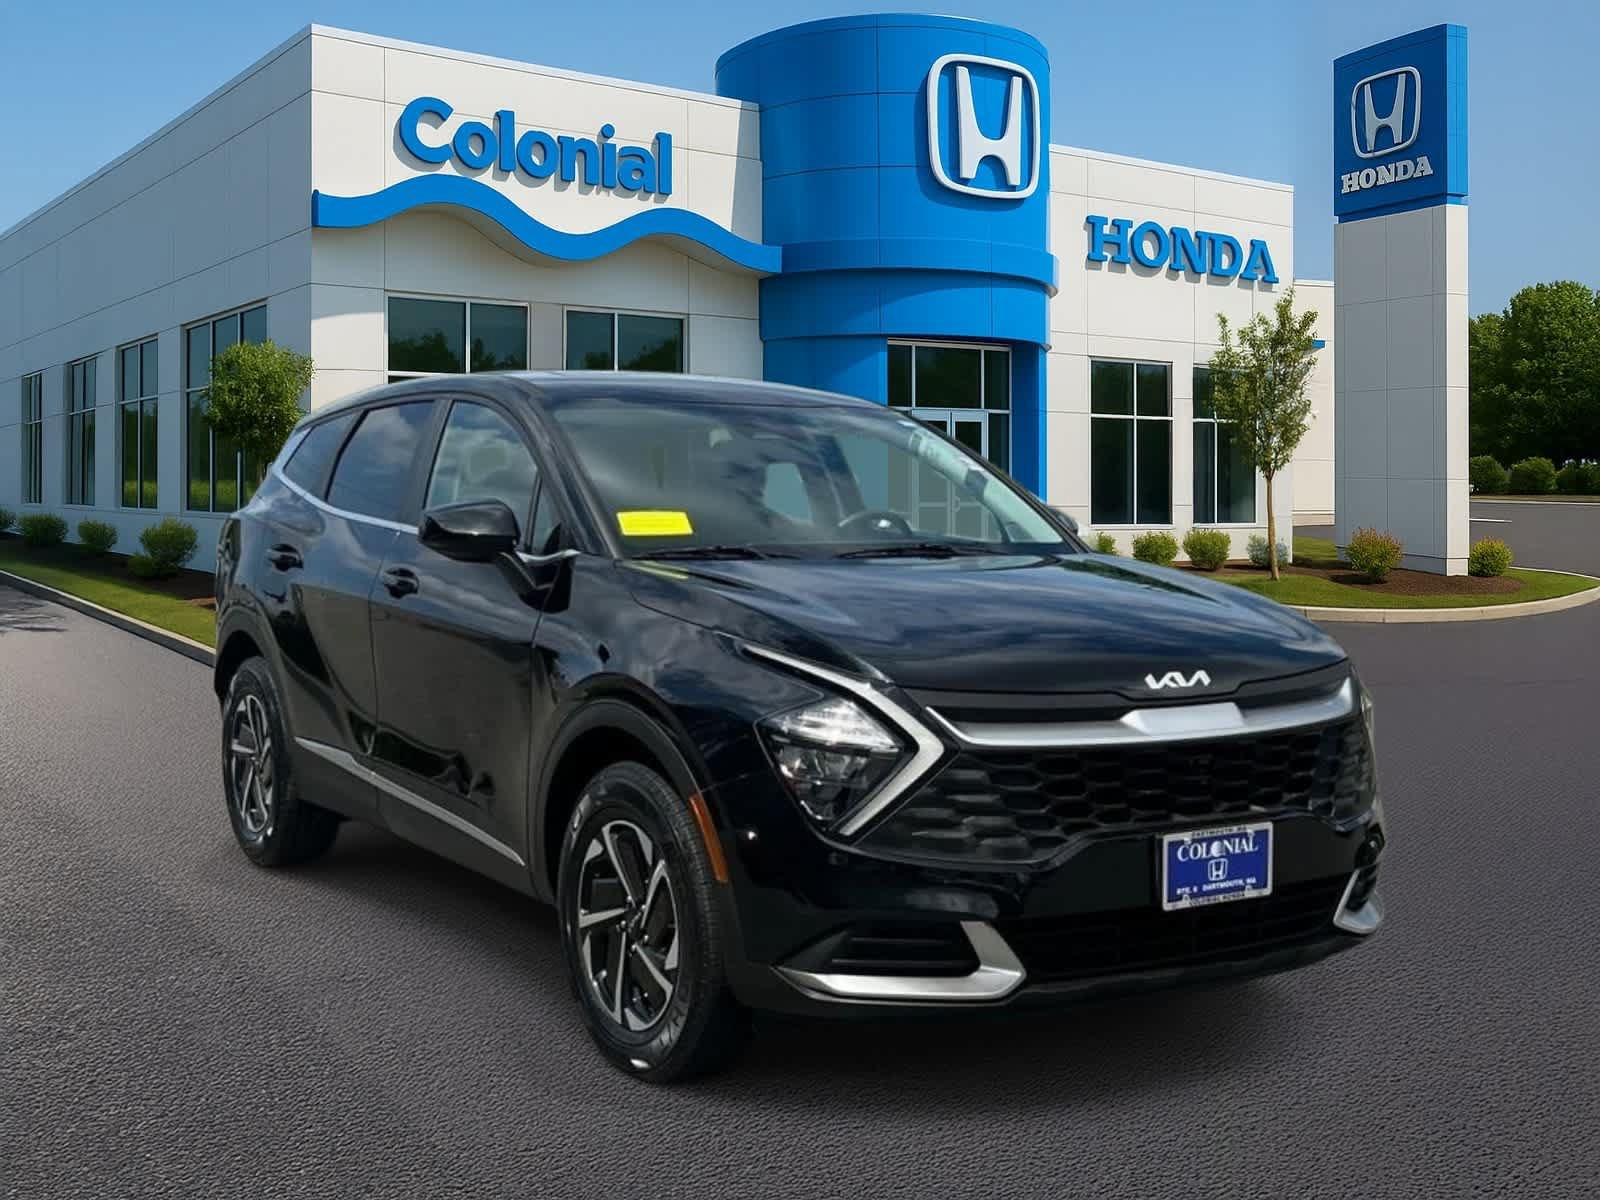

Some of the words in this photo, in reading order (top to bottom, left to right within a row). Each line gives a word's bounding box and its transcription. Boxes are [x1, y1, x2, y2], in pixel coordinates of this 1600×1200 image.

[399, 96, 673, 195] Colonial
[1341, 156, 1434, 195] HONDA
[1085, 215, 1280, 285] HONDA
[1177, 838, 1259, 862] COLONIAL
